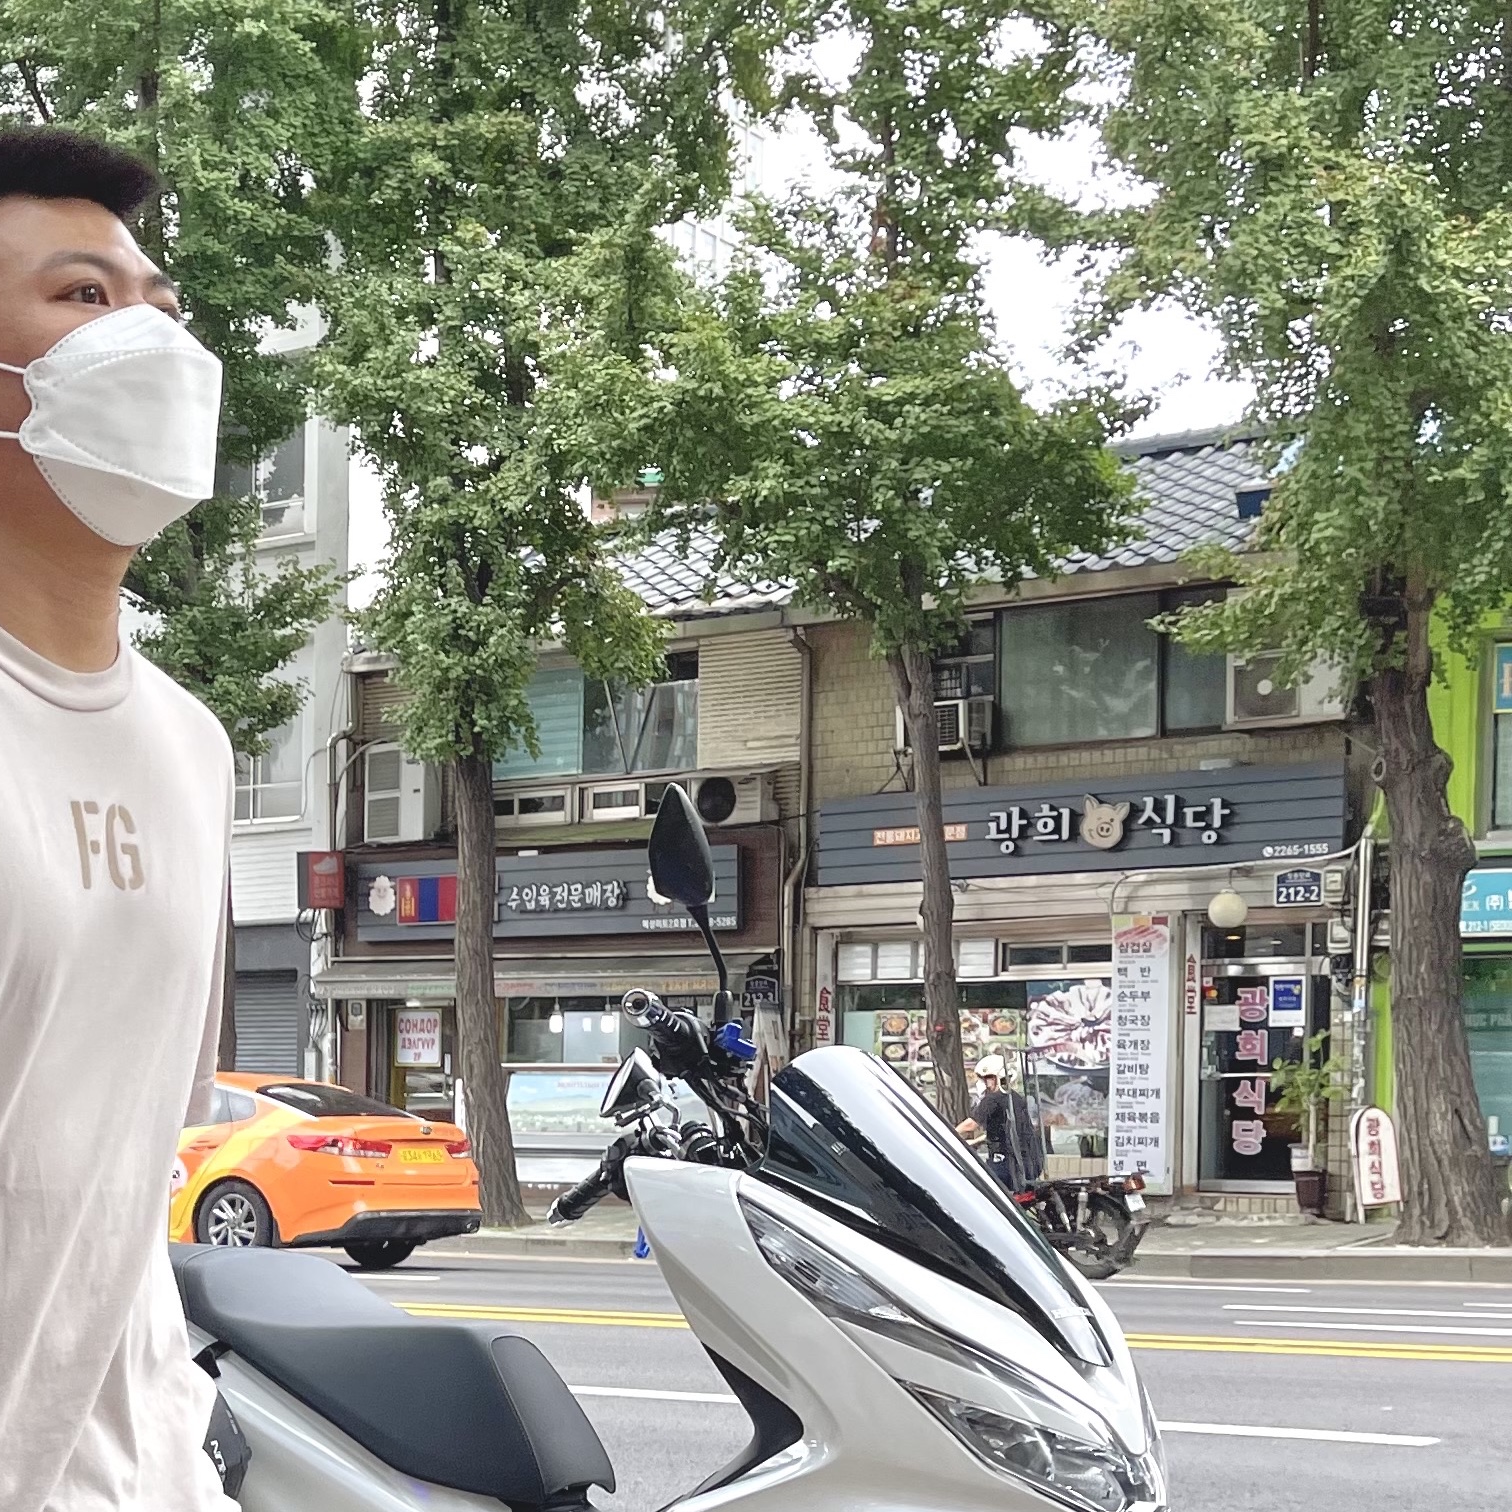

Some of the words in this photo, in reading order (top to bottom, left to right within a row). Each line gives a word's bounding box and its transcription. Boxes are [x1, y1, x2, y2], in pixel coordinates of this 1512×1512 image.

[985, 806, 1071, 854] 광희
[1138, 794, 1231, 845] 식당
[70, 800, 145, 891] FG
[1273, 843, 1329, 857] 2265-1555
[507, 880, 626, 911] 수입육전문매장
[1278, 885, 1320, 903] 212-2
[1119, 942, 1153, 953] 삼겹살
[1117, 990, 1151, 1003] 순두부
[816, 986, 832, 1042] 食堂
[1117, 1014, 1151, 1027] 청국장
[1116, 1039, 1151, 1051] 육개장
[1116, 1063, 1150, 1075] 갈비탕
[1232, 986, 1270, 1156] 광희식당
[1115, 1087, 1161, 1099] 부대찌개
[1114, 1135, 1160, 1148] 김치찌개
[1366, 1117, 1385, 1199] 광희식당
